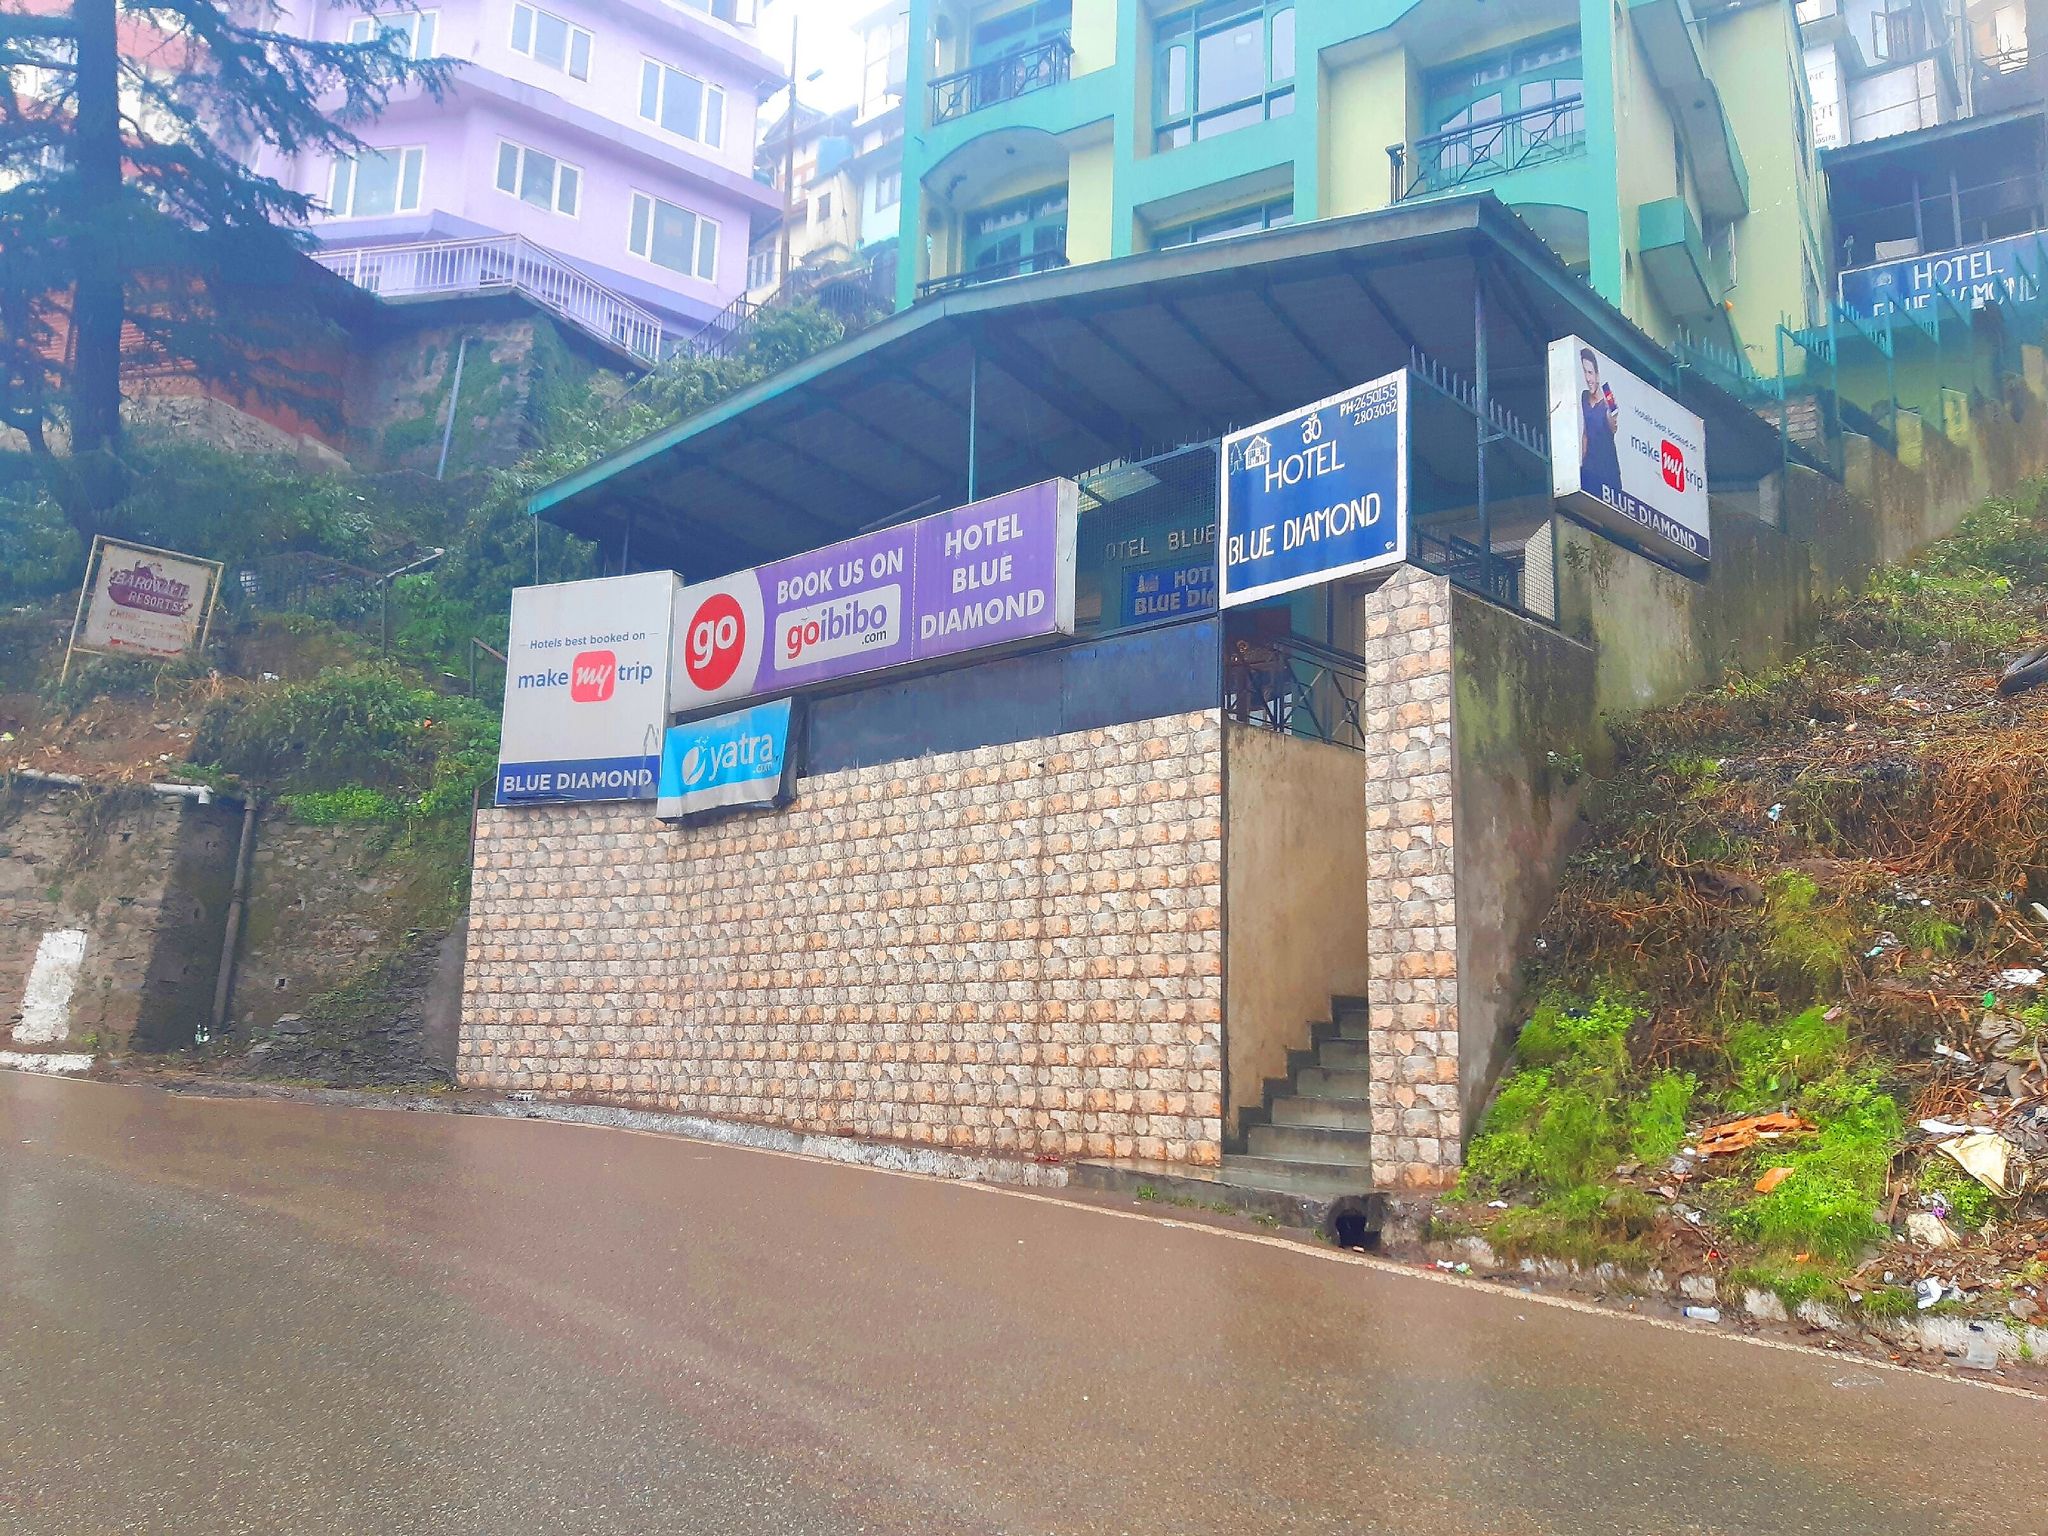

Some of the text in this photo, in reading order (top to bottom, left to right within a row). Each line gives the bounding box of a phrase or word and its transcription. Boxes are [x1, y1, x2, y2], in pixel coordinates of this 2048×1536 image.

[1914, 251, 2004, 290] HOTEL
[1353, 399, 1397, 426] 2803092
[1264, 440, 1345, 493] HOTEL
[1631, 435, 1703, 491] make my trip
[945, 512, 1024, 556] HOTEL
[1168, 524, 1215, 550] BLUE
[1229, 492, 1381, 566] BLUE DIAMOND
[1602, 484, 1697, 552] BLUE DIAMOND
[777, 547, 903, 605] BOOK US ON
[952, 555, 1013, 594] BLUE
[921, 589, 1045, 640] DIAMOND
[1134, 592, 1181, 616] BLUE
[530, 632, 646, 650] Hotels best booked on
[693, 615, 737, 670] go
[787, 600, 887, 660] goibibo
[861, 629, 887, 646] .com
[518, 661, 653, 698] make my trip
[709, 732, 773, 782] yatra
[503, 768, 653, 793] BLUE DIAMOND
